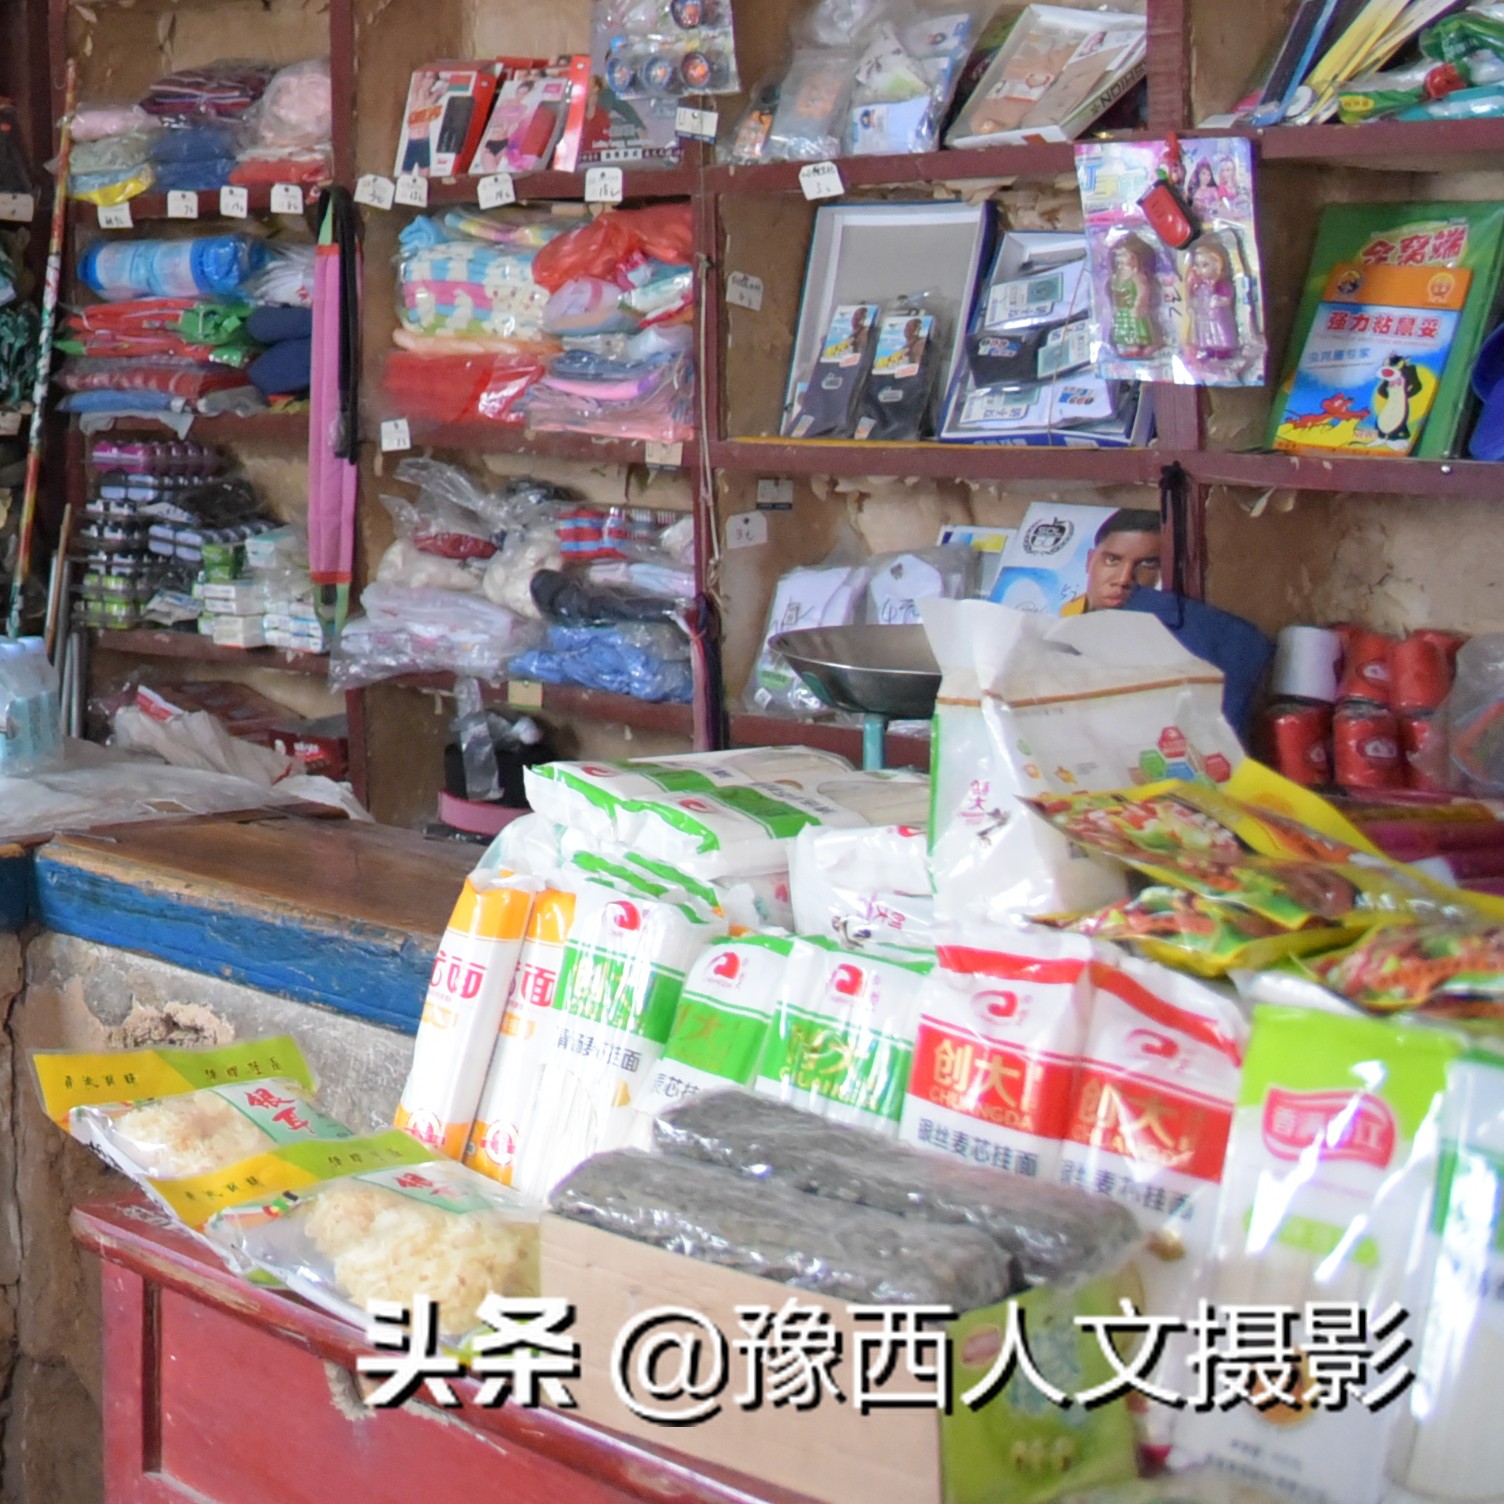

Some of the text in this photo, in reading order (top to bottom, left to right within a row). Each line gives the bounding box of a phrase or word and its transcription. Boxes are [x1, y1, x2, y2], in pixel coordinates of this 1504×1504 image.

[934, 1037, 1022, 1109] 创大
[917, 1114, 1039, 1179] 银丝麦芯挂面
